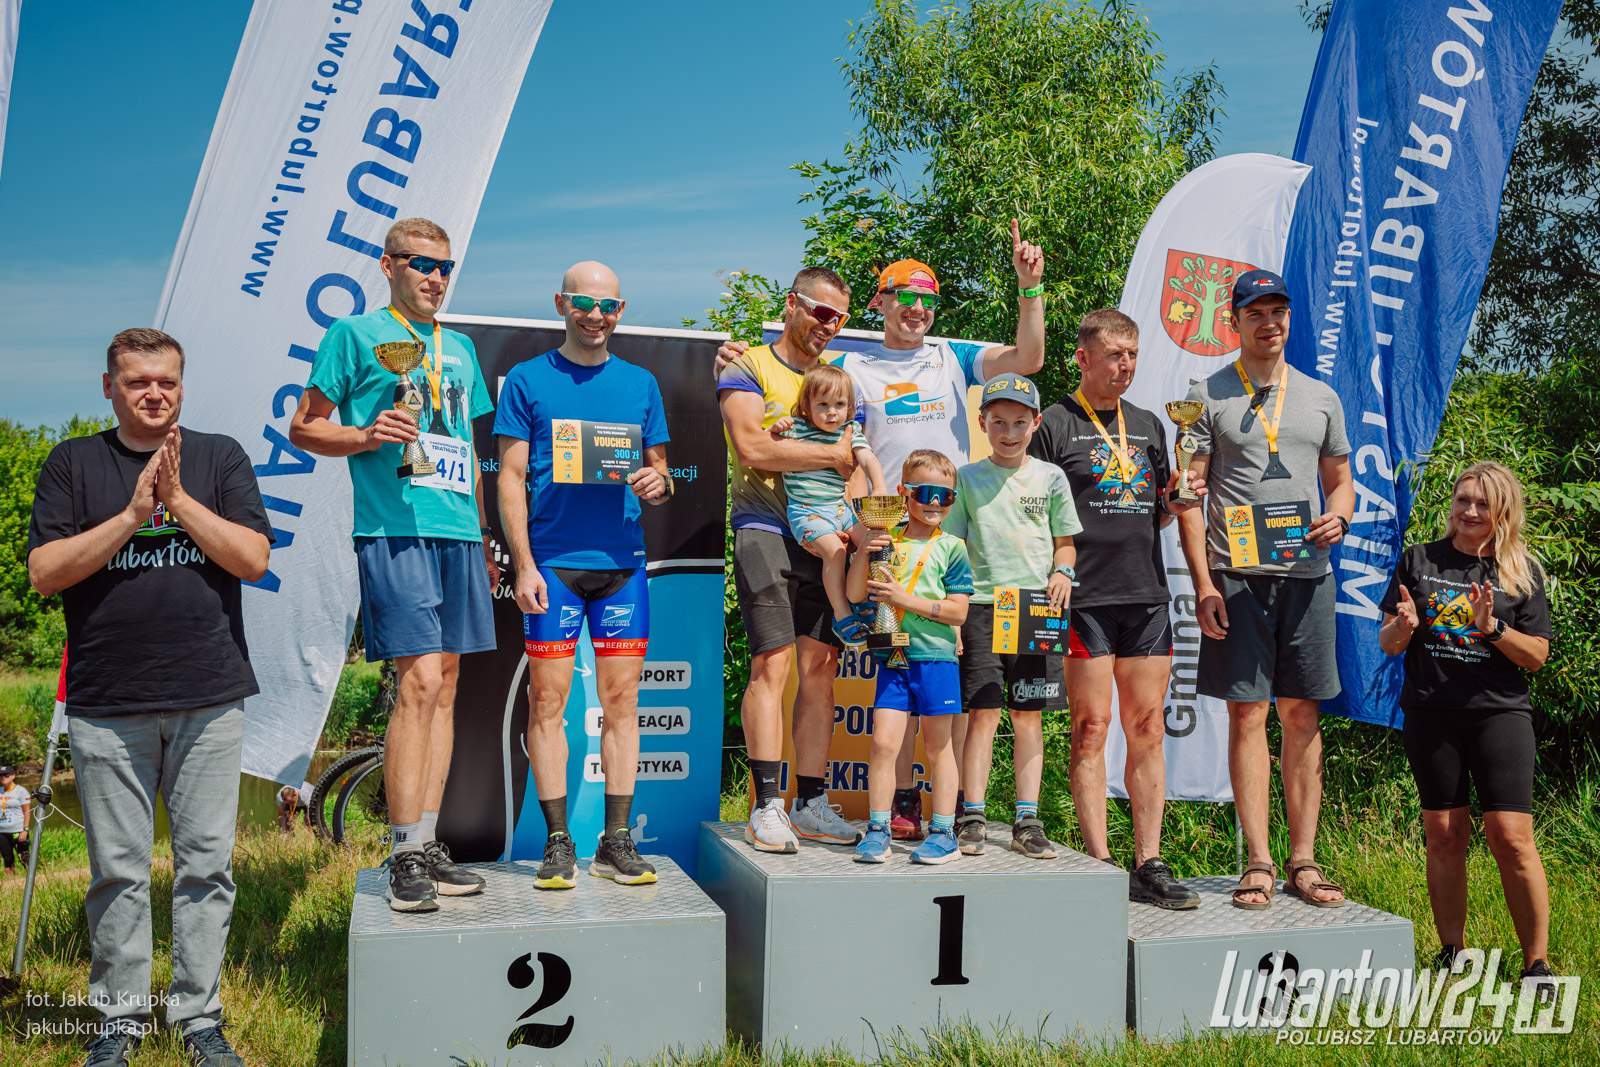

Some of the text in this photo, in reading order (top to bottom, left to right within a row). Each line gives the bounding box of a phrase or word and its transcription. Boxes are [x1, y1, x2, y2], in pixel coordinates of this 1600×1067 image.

[921, 402, 945, 413] UKS
[886, 412, 945, 425] Olimpijczyk 23
[593, 436, 632, 449] VOUCHER
[614, 449, 630, 459] 300
[426, 456, 466, 483] 4/1
[1020, 496, 1048, 504] SOUT
[1265, 516, 1302, 529] VOUCHER
[1286, 527, 1301, 538] 200
[1165, 593, 1201, 738] Gmina
[930, 894, 970, 986] 1
[507, 951, 574, 1050] 2
